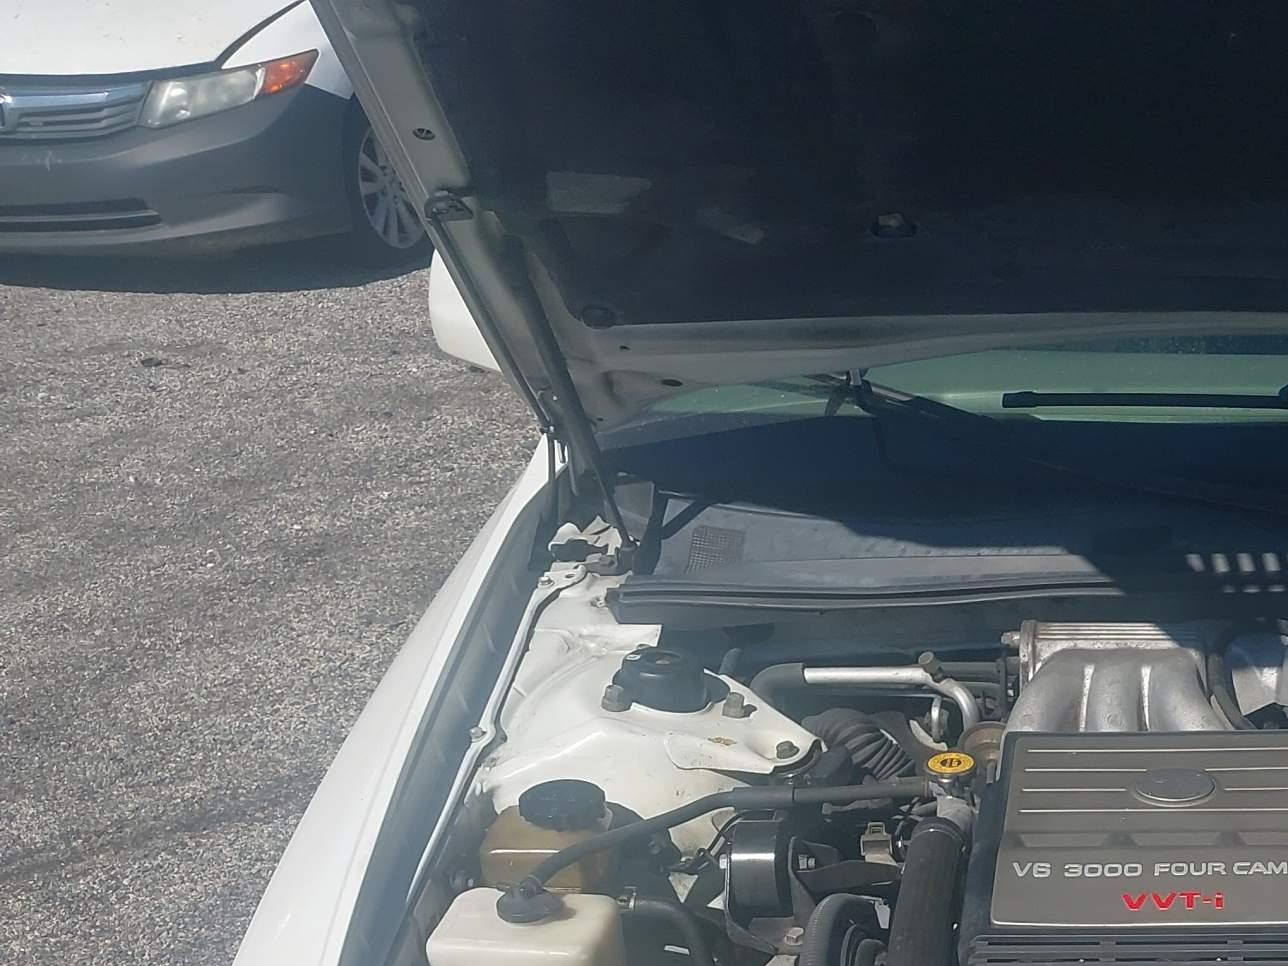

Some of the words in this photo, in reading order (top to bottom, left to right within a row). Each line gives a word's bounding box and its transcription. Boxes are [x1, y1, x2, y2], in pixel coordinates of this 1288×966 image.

[1013, 862, 1051, 877] V6
[1064, 863, 1143, 877] 3000
[1153, 862, 1227, 876] FOUR
[1232, 861, 1288, 875] CAM
[1121, 890, 1224, 911] VVT-i
